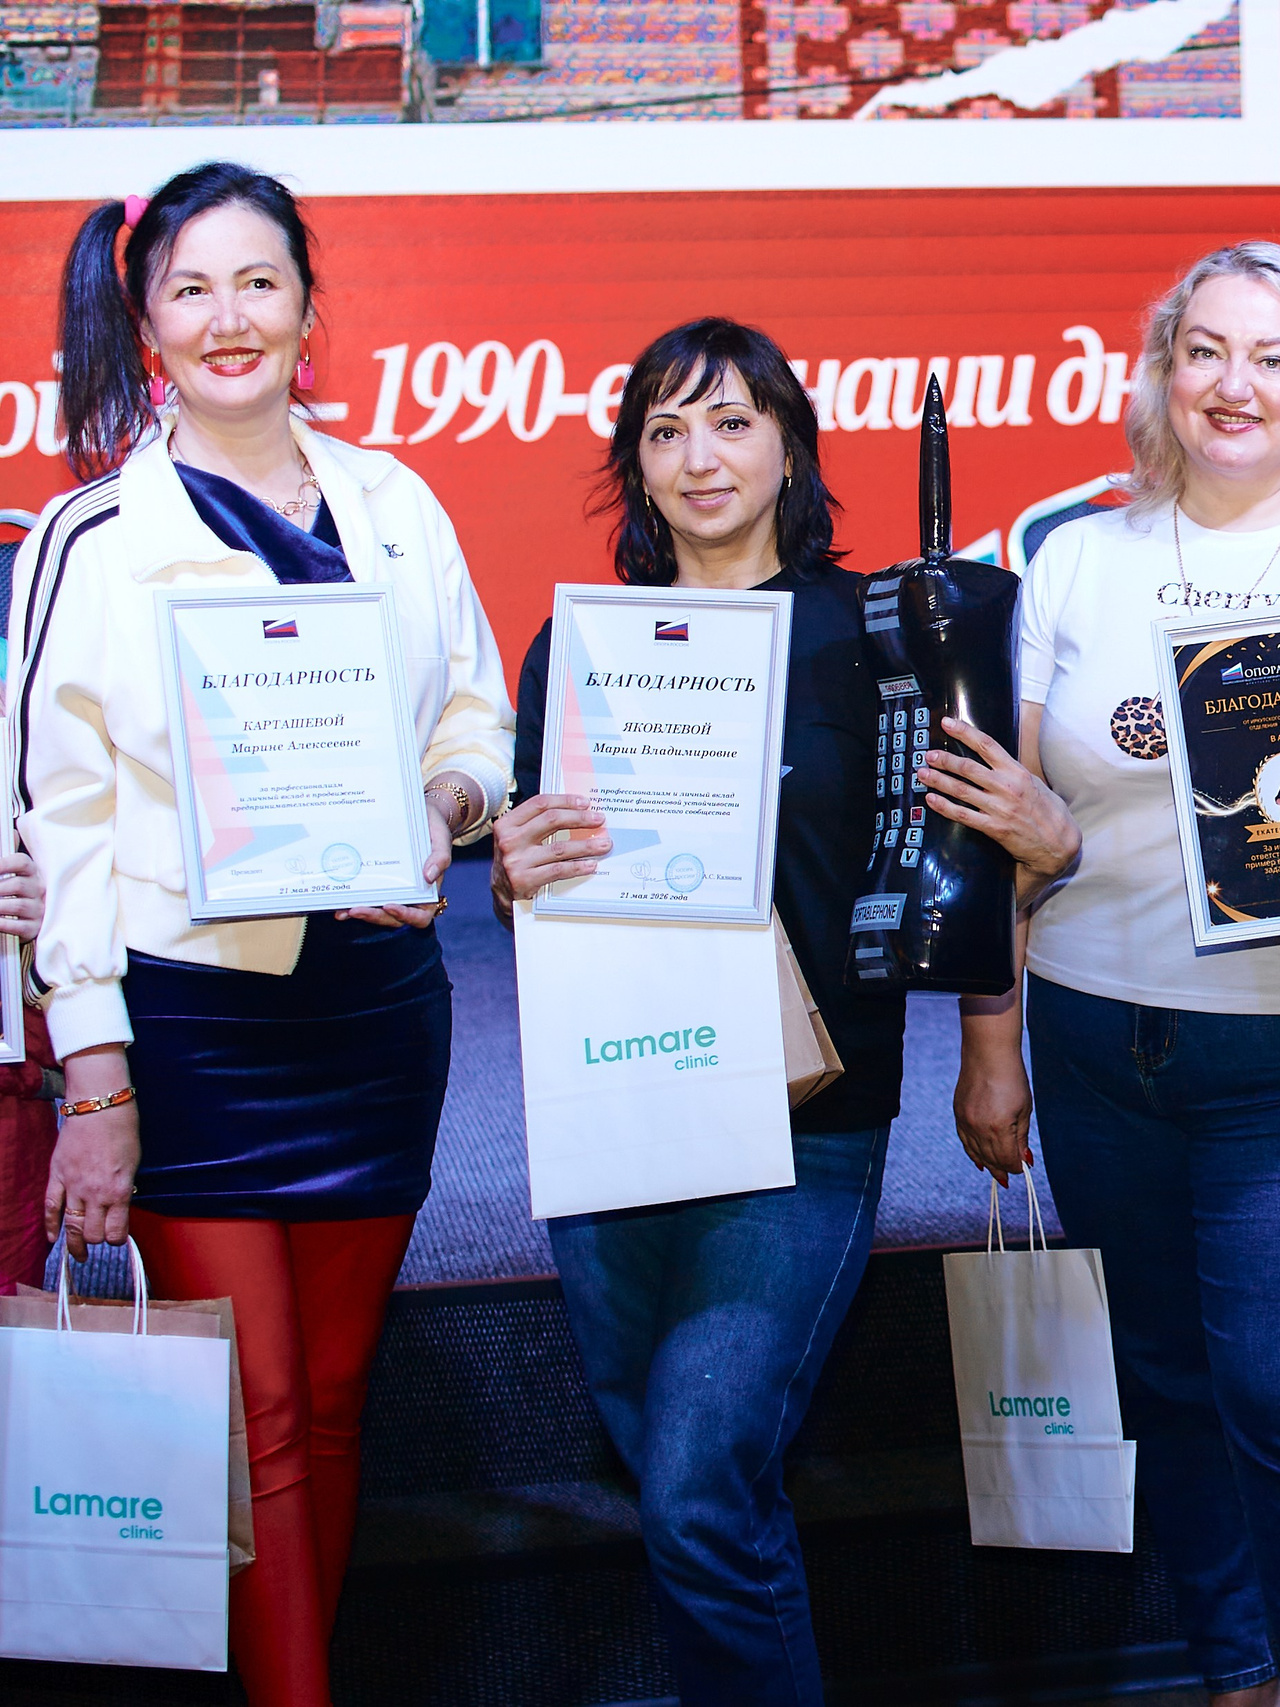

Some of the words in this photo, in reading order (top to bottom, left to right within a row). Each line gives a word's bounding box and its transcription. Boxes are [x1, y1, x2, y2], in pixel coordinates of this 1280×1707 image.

[1047, 325, 1140, 426] дн
[202, 667, 376, 689] БЛАГОДАРНОСТЬ
[585, 672, 756, 692] БЛАГОДАРНОСТЬ
[243, 713, 345, 732] КАРТАШЕВОЙ
[896, 713, 902, 725] 2
[917, 710, 924, 722] 3
[622, 721, 712, 736] ЯКОВЛЕВОЙ
[895, 734, 901, 746] 5
[917, 732, 924, 744] 6
[1270, 735, 1275, 743] В
[232, 743, 284, 755] Марине
[287, 739, 361, 751] Алексеевне
[592, 743, 637, 757] Марии
[641, 745, 738, 759] Владимировне
[894, 756, 900, 768] 8
[916, 753, 923, 765] 9
[600, 787, 671, 797] профессионализм
[909, 830, 917, 841] E
[905, 850, 914, 861] V
[1263, 844, 1273, 852] За
[1245, 858, 1277, 870] пример
[279, 887, 288, 895] 21
[290, 886, 309, 894] мая
[311, 884, 330, 892] 2026
[332, 883, 351, 892] года
[670, 893, 688, 902] года
[585, 1025, 716, 1064] Lamare
[674, 1053, 719, 1070] clinic
[988, 1391, 1071, 1417] Lamare
[1044, 1422, 1074, 1435] clinic
[34, 1486, 163, 1520] Lamare
[119, 1525, 164, 1540] clinic
